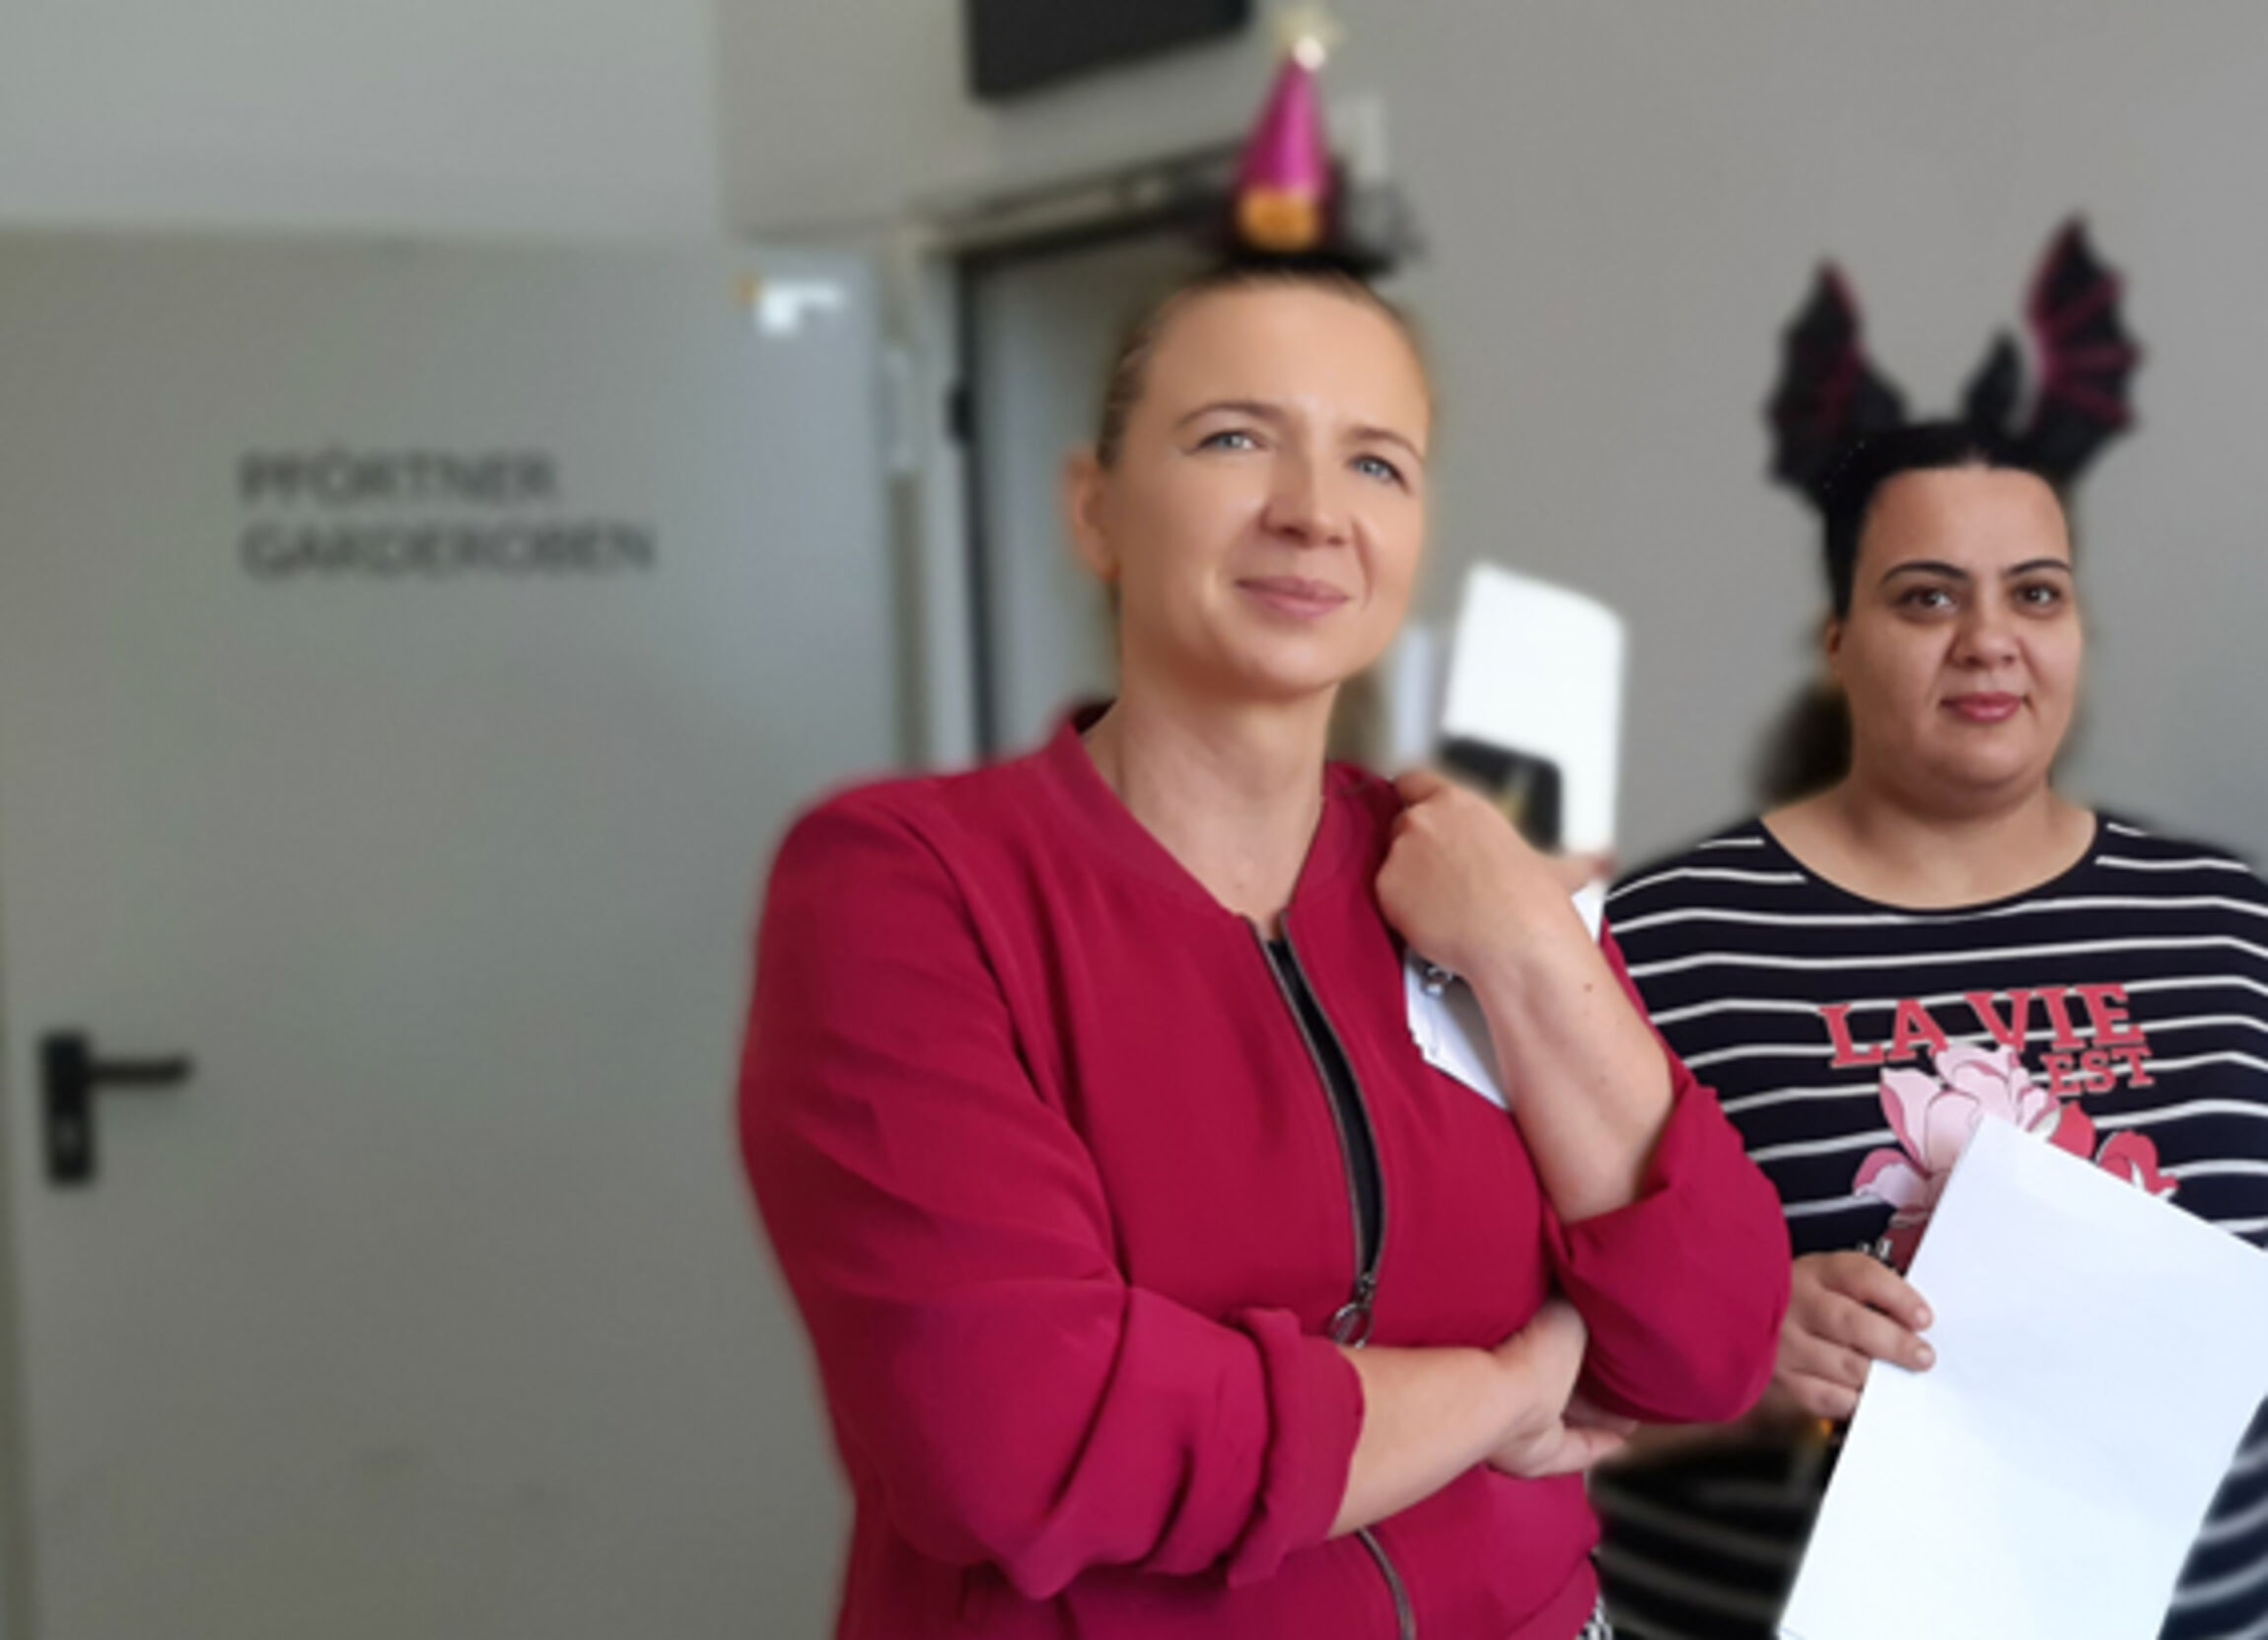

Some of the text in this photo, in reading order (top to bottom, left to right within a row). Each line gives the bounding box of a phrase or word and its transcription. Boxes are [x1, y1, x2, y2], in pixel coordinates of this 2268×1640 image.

[239, 521, 657, 579] GARDEROBEN
[1819, 983, 2147, 1067] LA VIE
[2040, 1046, 2156, 1097] EST
